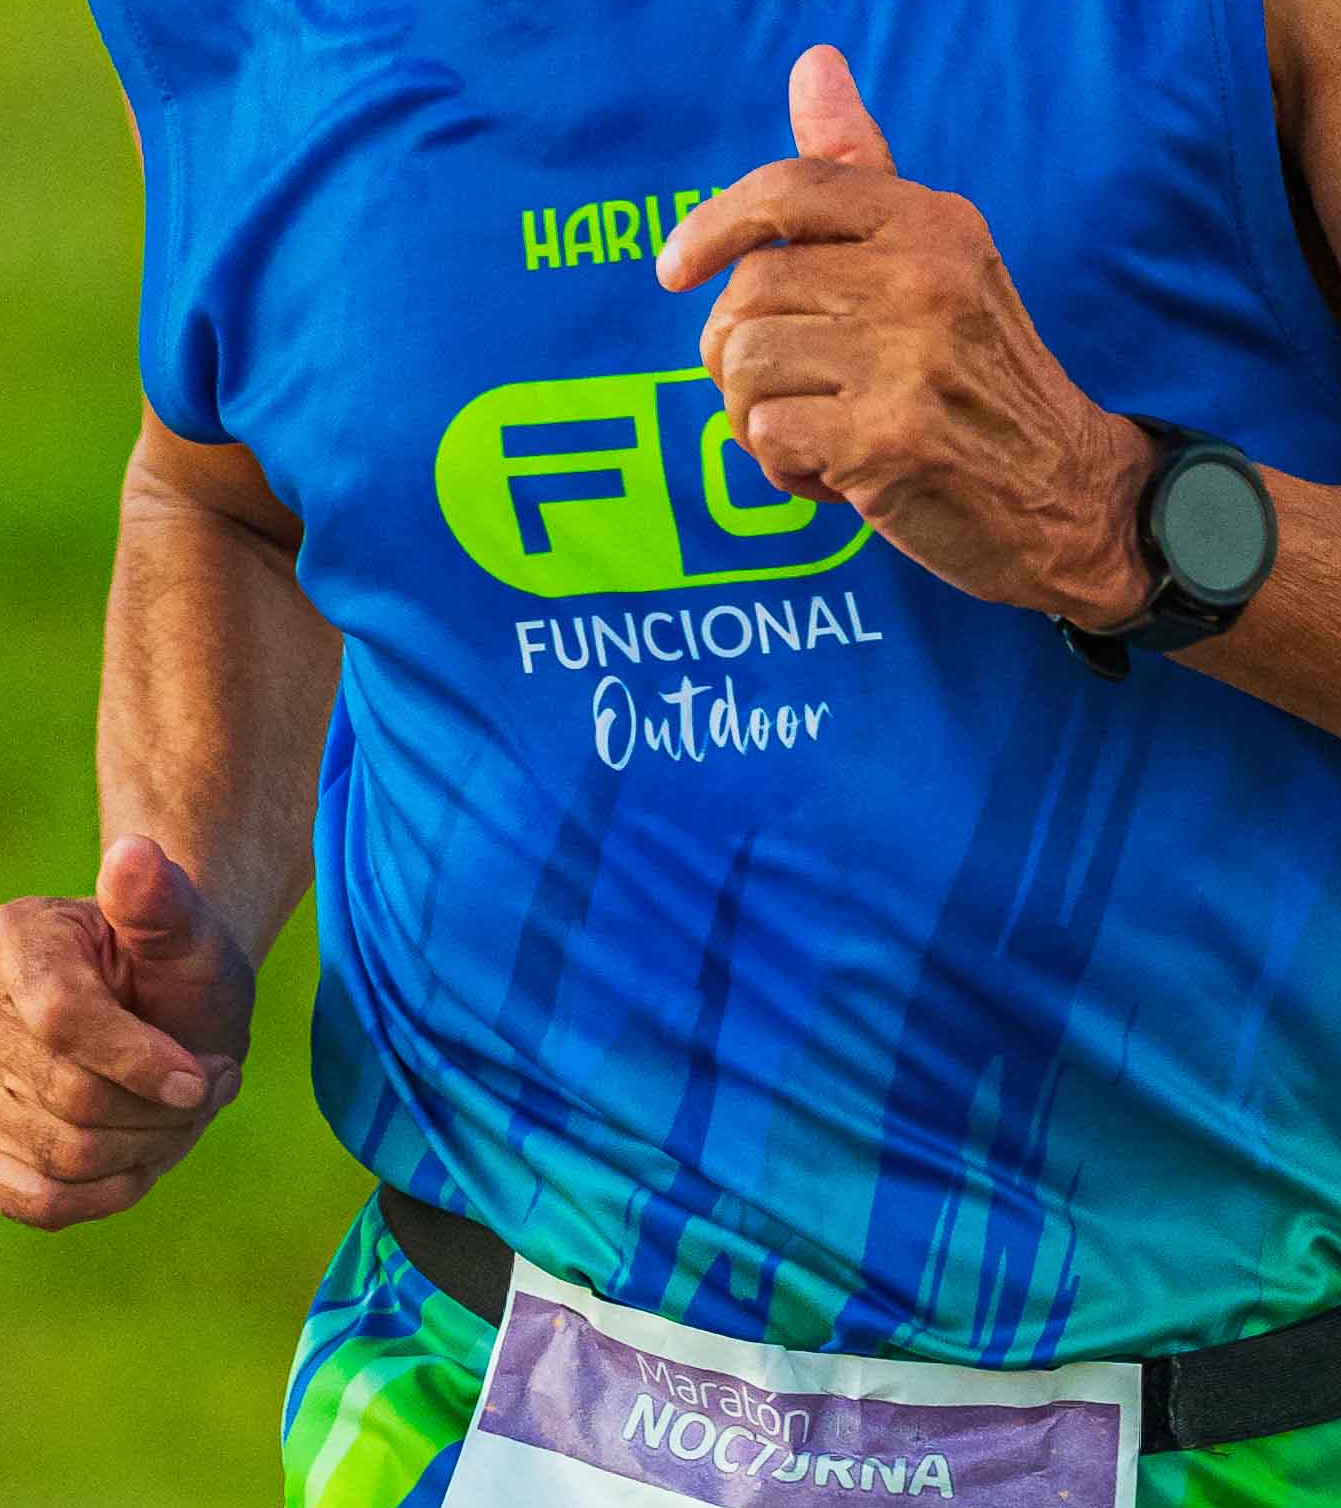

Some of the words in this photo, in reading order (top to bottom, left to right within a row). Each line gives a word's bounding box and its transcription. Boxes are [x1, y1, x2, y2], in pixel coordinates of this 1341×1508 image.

[522, 186, 725, 271] HARL
[516, 591, 883, 674] FUNCIONAL
[593, 675, 834, 771] Outdoor
[636, 1352, 810, 1443] Maratón
[622, 1392, 956, 1500] NOCTURNA
